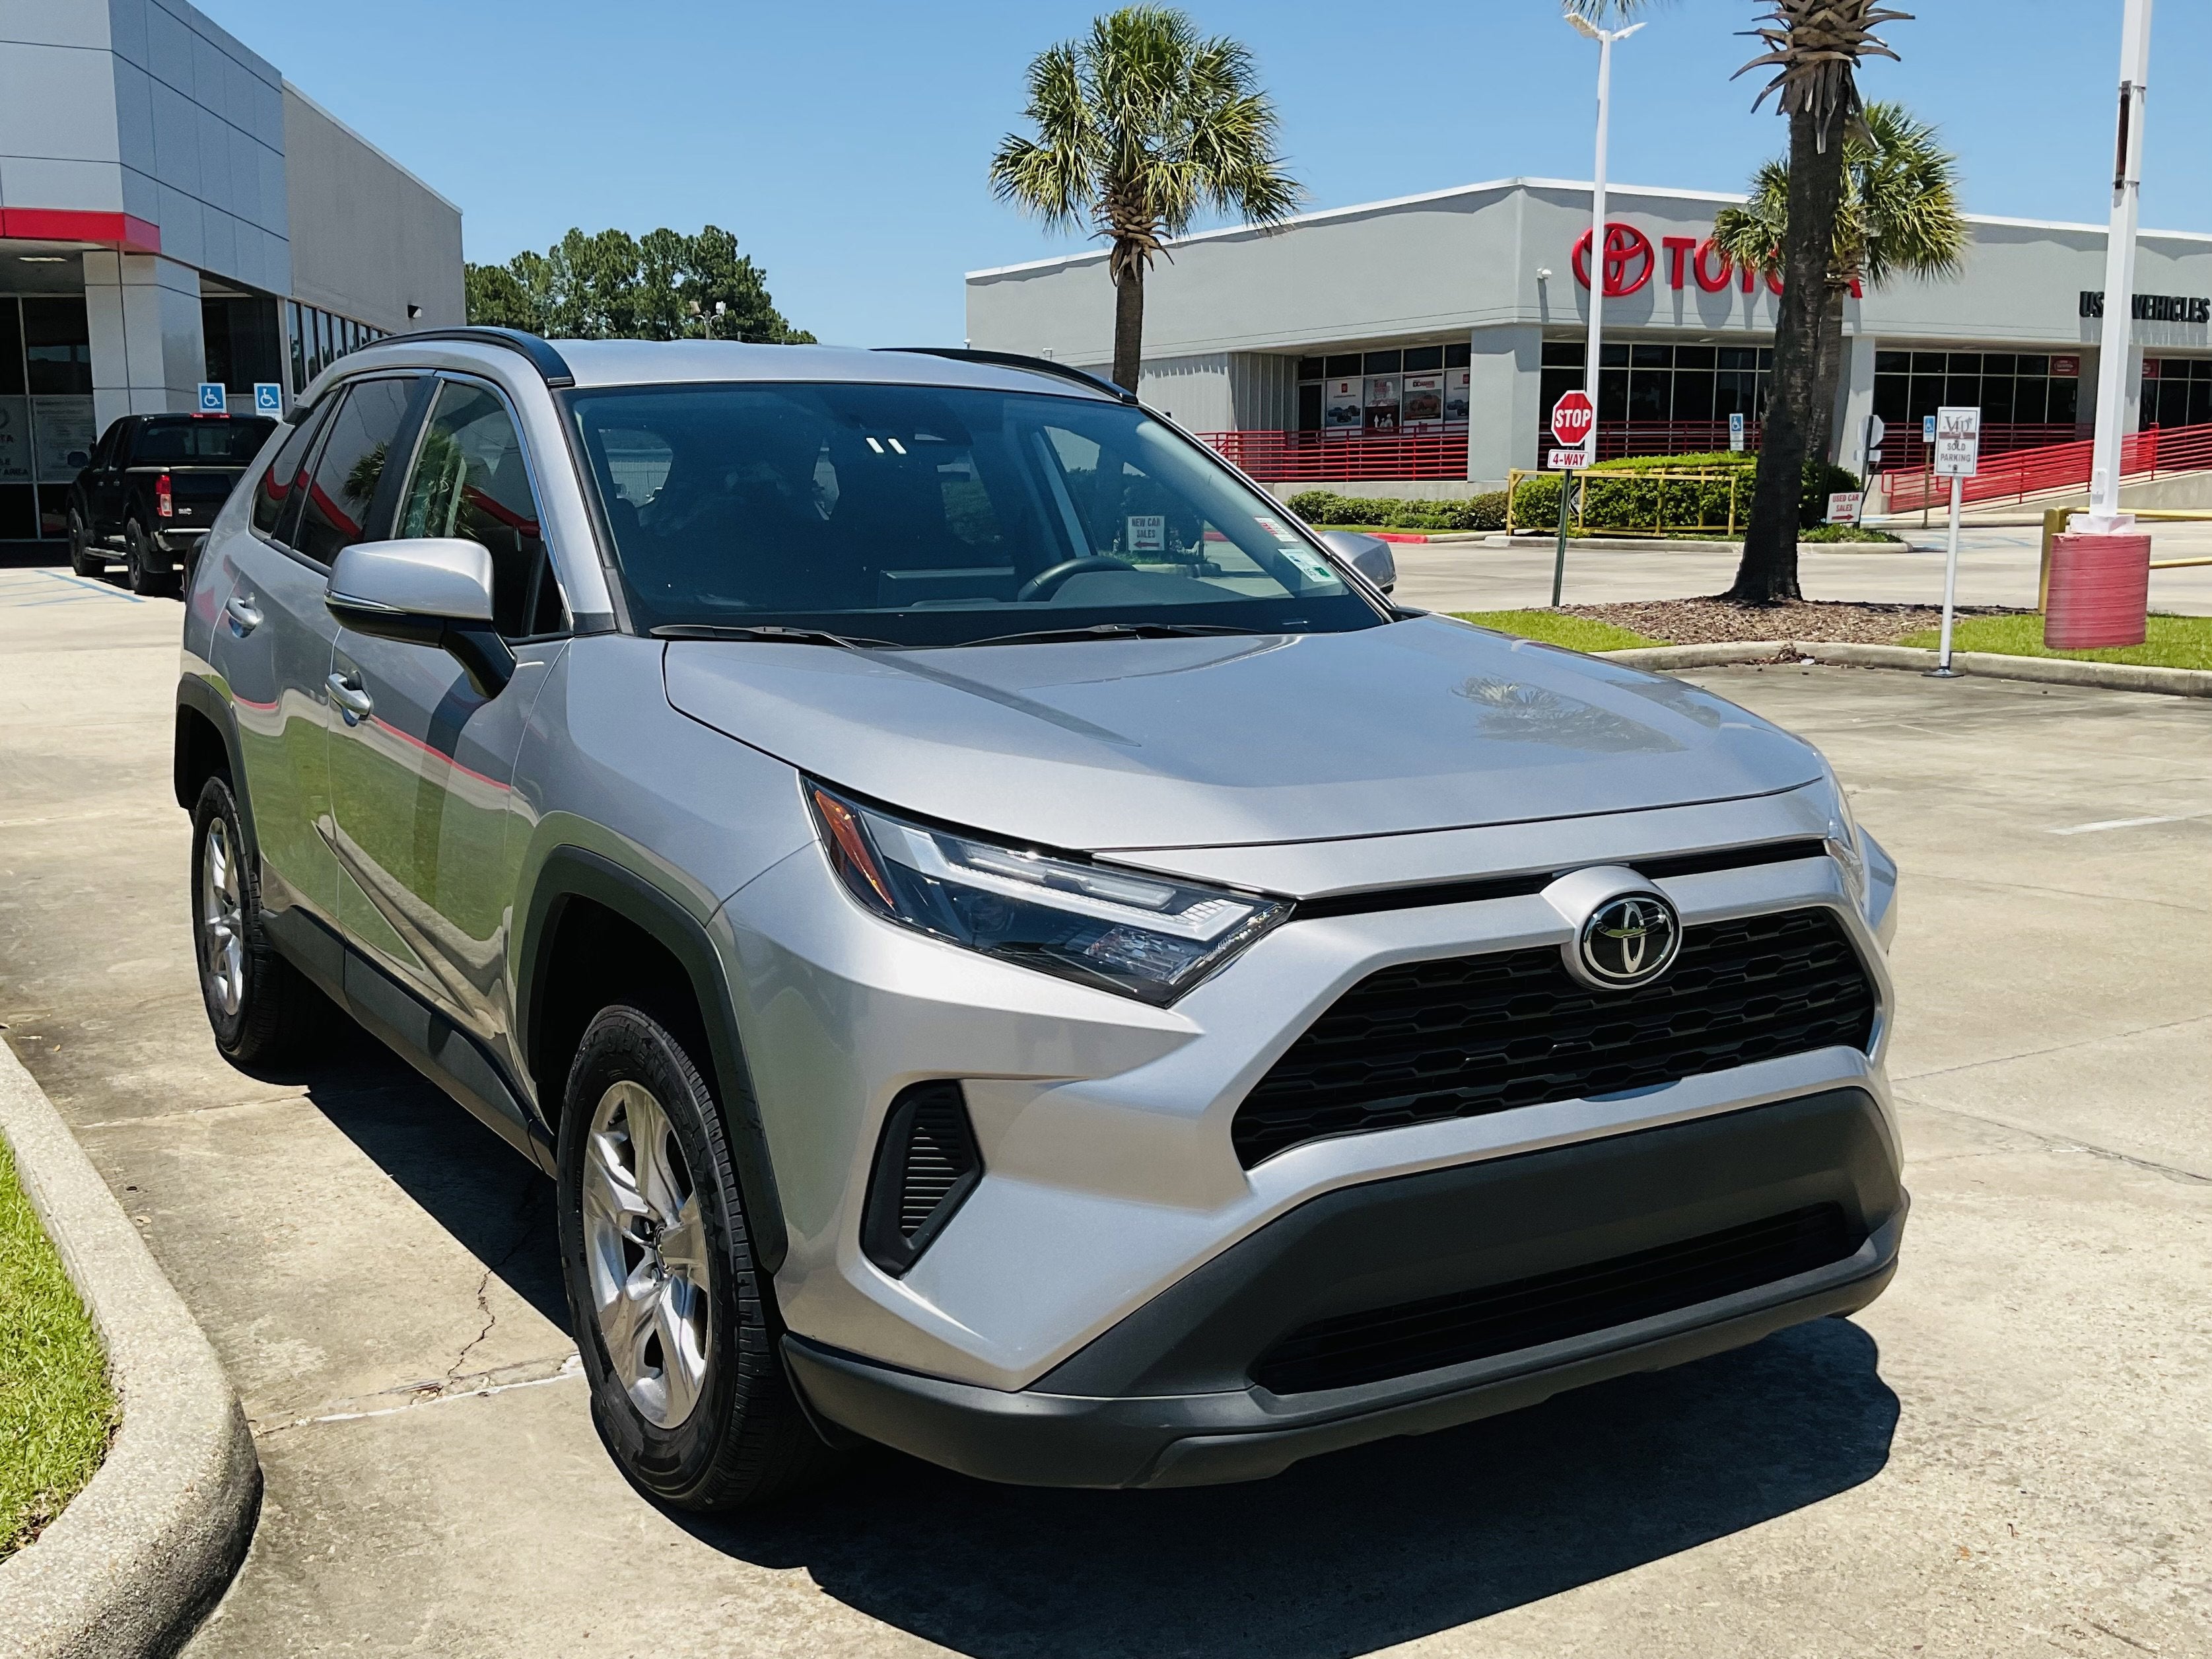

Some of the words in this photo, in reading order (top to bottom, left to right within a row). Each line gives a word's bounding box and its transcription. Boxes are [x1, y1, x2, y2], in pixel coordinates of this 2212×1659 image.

[2131, 294, 2210, 323] VEHICLES
[1555, 409, 1591, 428] STOP
[1947, 442, 1966, 451] SOLD
[1553, 453, 1585, 466] 4-WAY
[1940, 454, 1971, 462] PARKING
[1131, 518, 1146, 527] NEW
[1148, 518, 1160, 526] CAR
[1137, 530, 1156, 538] SALES
